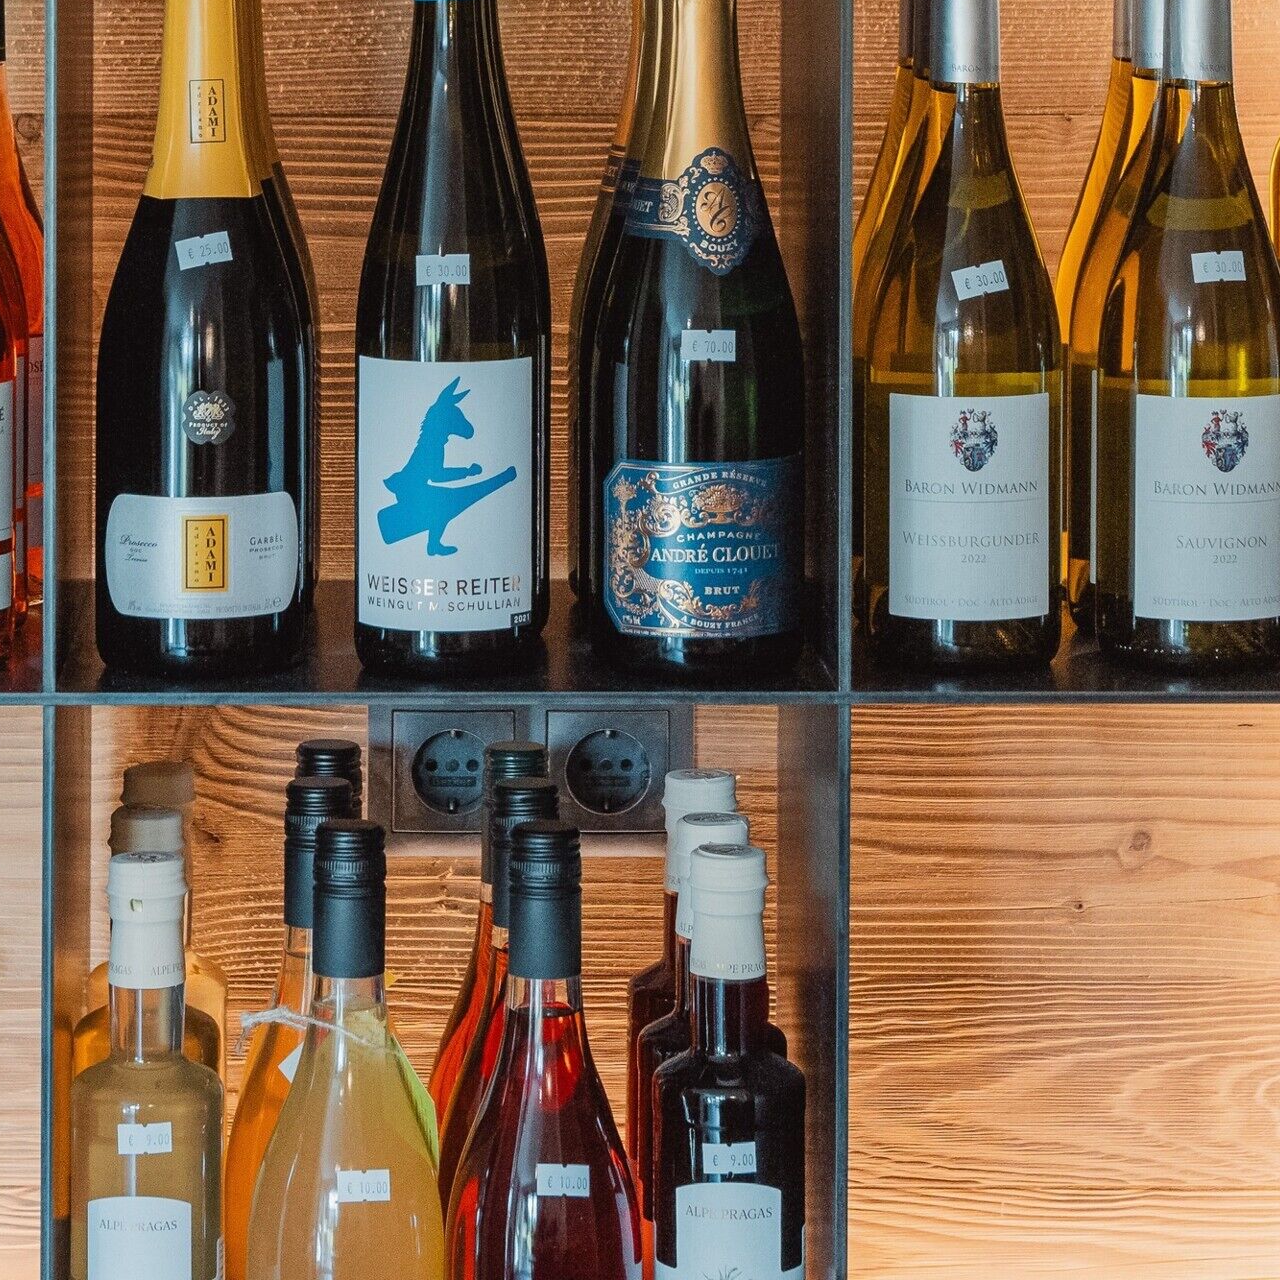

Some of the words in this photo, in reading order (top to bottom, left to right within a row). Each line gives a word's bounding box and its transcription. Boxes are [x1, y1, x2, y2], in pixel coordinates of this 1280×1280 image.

[208, 86, 219, 137] ADAMI
[200, 242, 229, 257] 25.00
[700, 239, 738, 252] BOUZY
[438, 265, 467, 277] 30.00
[1214, 261, 1242, 273] 30.00
[976, 271, 1005, 287] 30.00
[704, 341, 733, 354] 70.00
[673, 472, 718, 489] GRANDE
[722, 469, 768, 486] RÉSERVE
[905, 479, 955, 494] BARON
[962, 481, 1038, 495] WIDMANN
[1154, 481, 1207, 495] BARON
[120, 534, 158, 547] Prosecco
[676, 532, 761, 542] CHAMPAGNE
[902, 531, 1040, 547] WEISSBURGUNDER
[1176, 535, 1267, 549] SAUVIGNON
[205, 526, 217, 582] ADAMI
[651, 544, 708, 562] ANDRÉ
[713, 544, 781, 562] CLOUET
[961, 554, 987, 563] 2022
[1212, 555, 1237, 564] 2022
[367, 573, 448, 596] WEISSER
[457, 576, 521, 595] REITER
[704, 586, 740, 595] BRUT
[904, 594, 947, 606] SÜDTIROL
[958, 598, 980, 607] DOC
[514, 613, 530, 623] 2021
[690, 620, 722, 629] BOUZY
[146, 1134, 169, 1146] 9.00
[731, 1154, 754, 1166] 9.00
[359, 1182, 388, 1194] 10.00
[560, 1176, 588, 1190] 10.00
